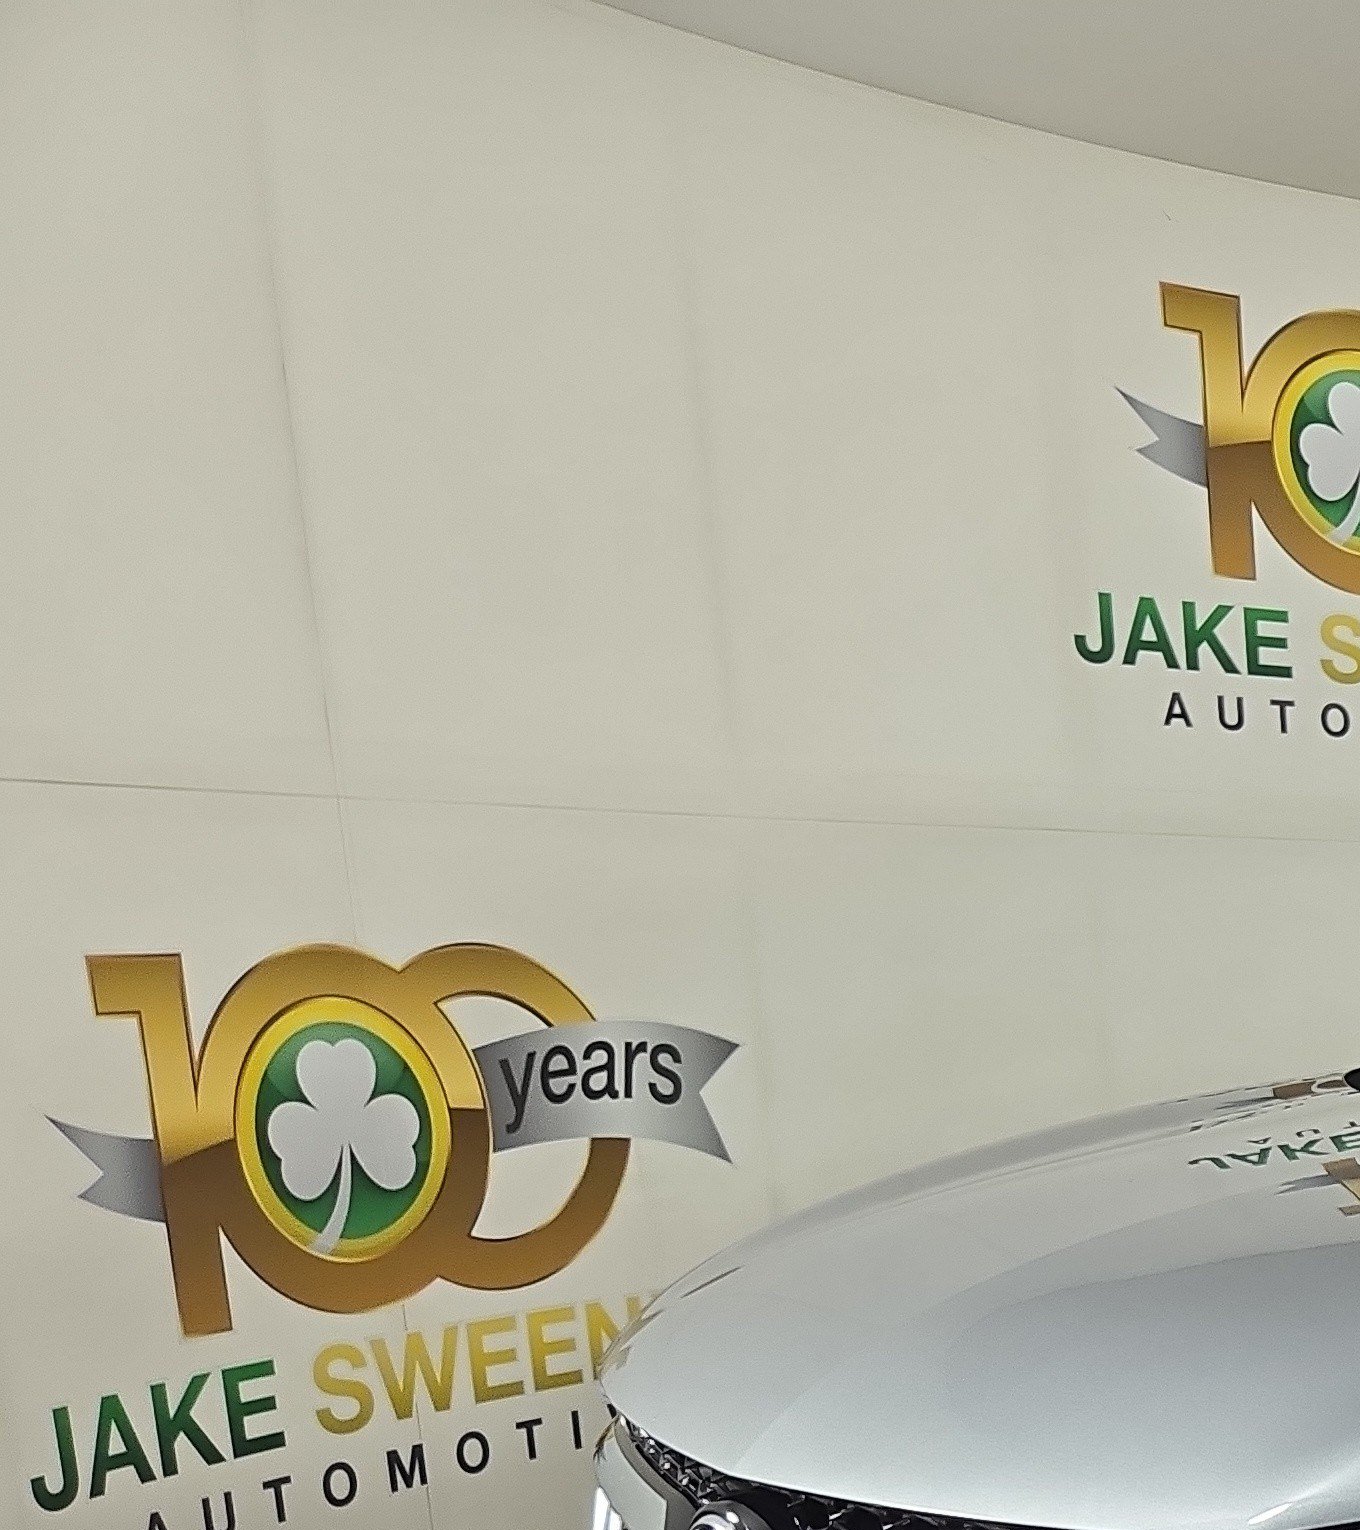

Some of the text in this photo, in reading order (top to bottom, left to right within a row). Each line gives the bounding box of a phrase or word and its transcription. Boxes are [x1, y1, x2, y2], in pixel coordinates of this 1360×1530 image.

[1074, 592, 1293, 679] JAKE
[86, 942, 631, 1338] 100
[500, 1040, 684, 1133] years
[30, 1292, 648, 1514] JAKE SWEEN
